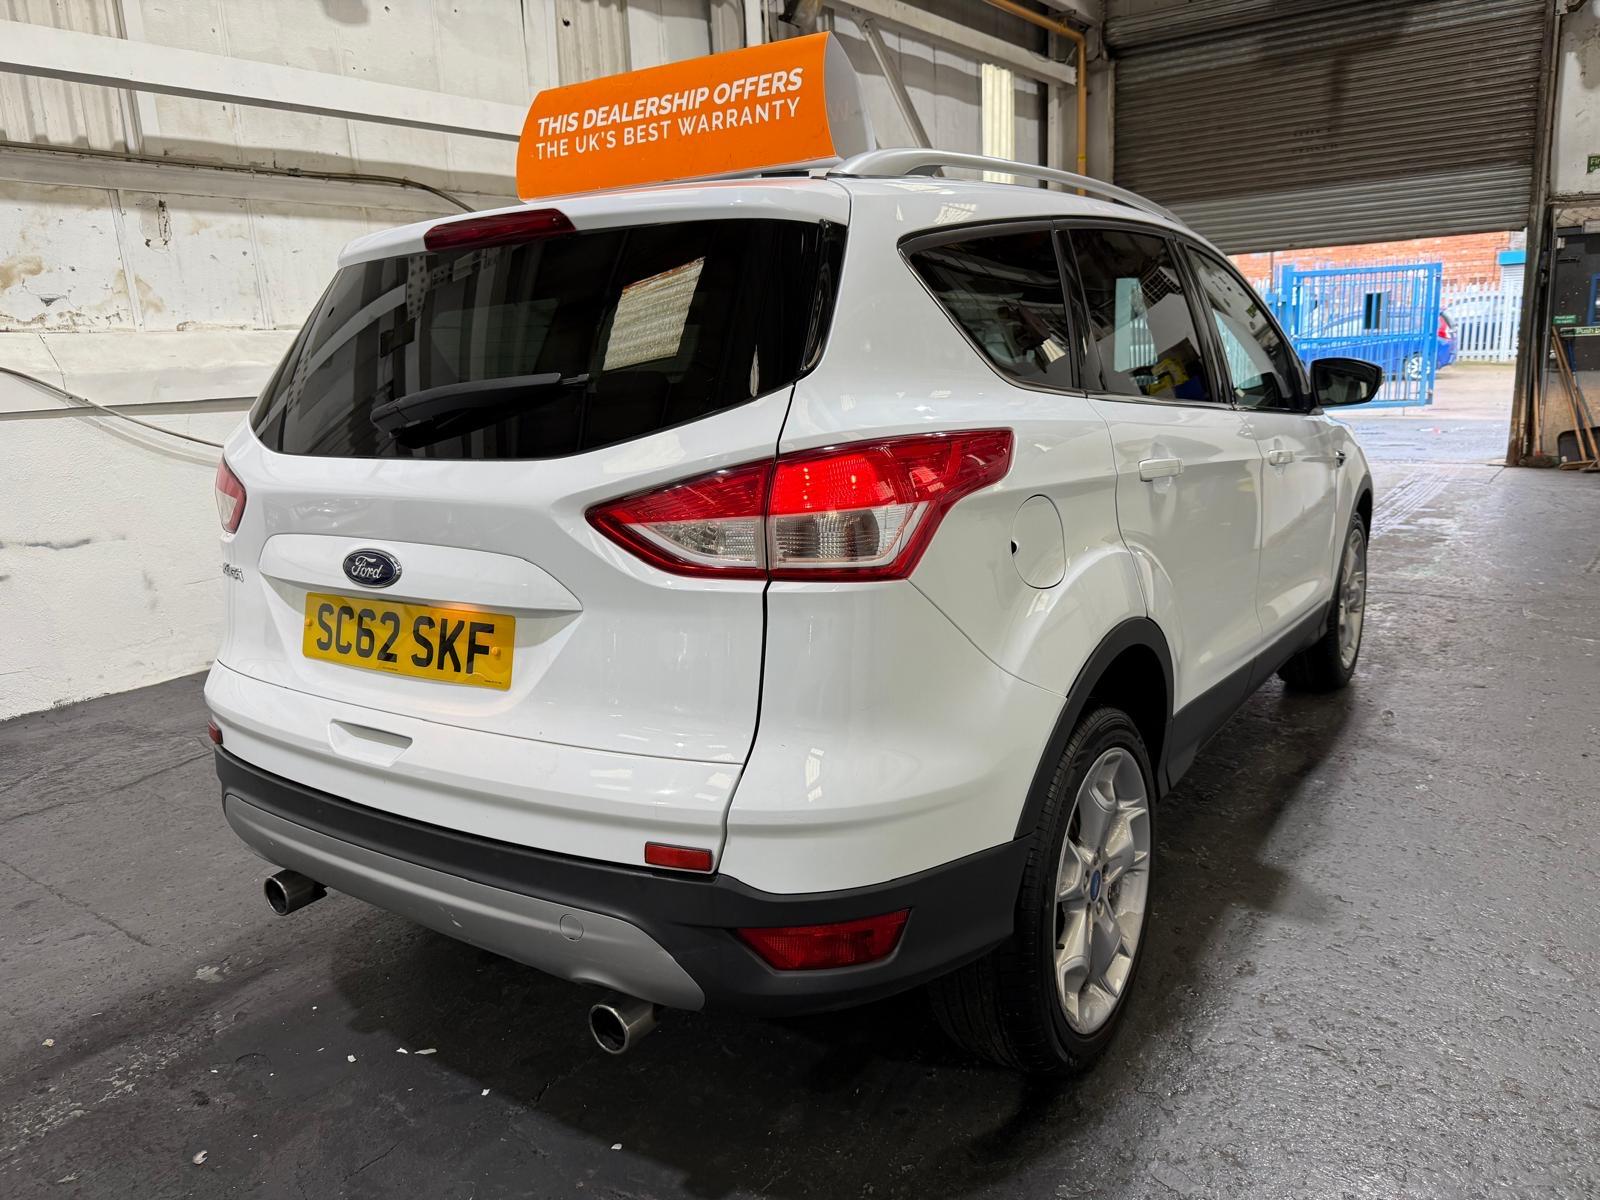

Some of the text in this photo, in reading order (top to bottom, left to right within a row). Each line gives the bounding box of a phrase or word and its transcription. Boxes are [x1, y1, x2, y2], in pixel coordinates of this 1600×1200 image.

[536, 96, 800, 160] THE UK'S BEST WARRANTY
[537, 67, 803, 137] THIS DEALERSHIP OFFERS
[351, 555, 384, 578] Ford
[316, 603, 495, 675] SC62 SKF
